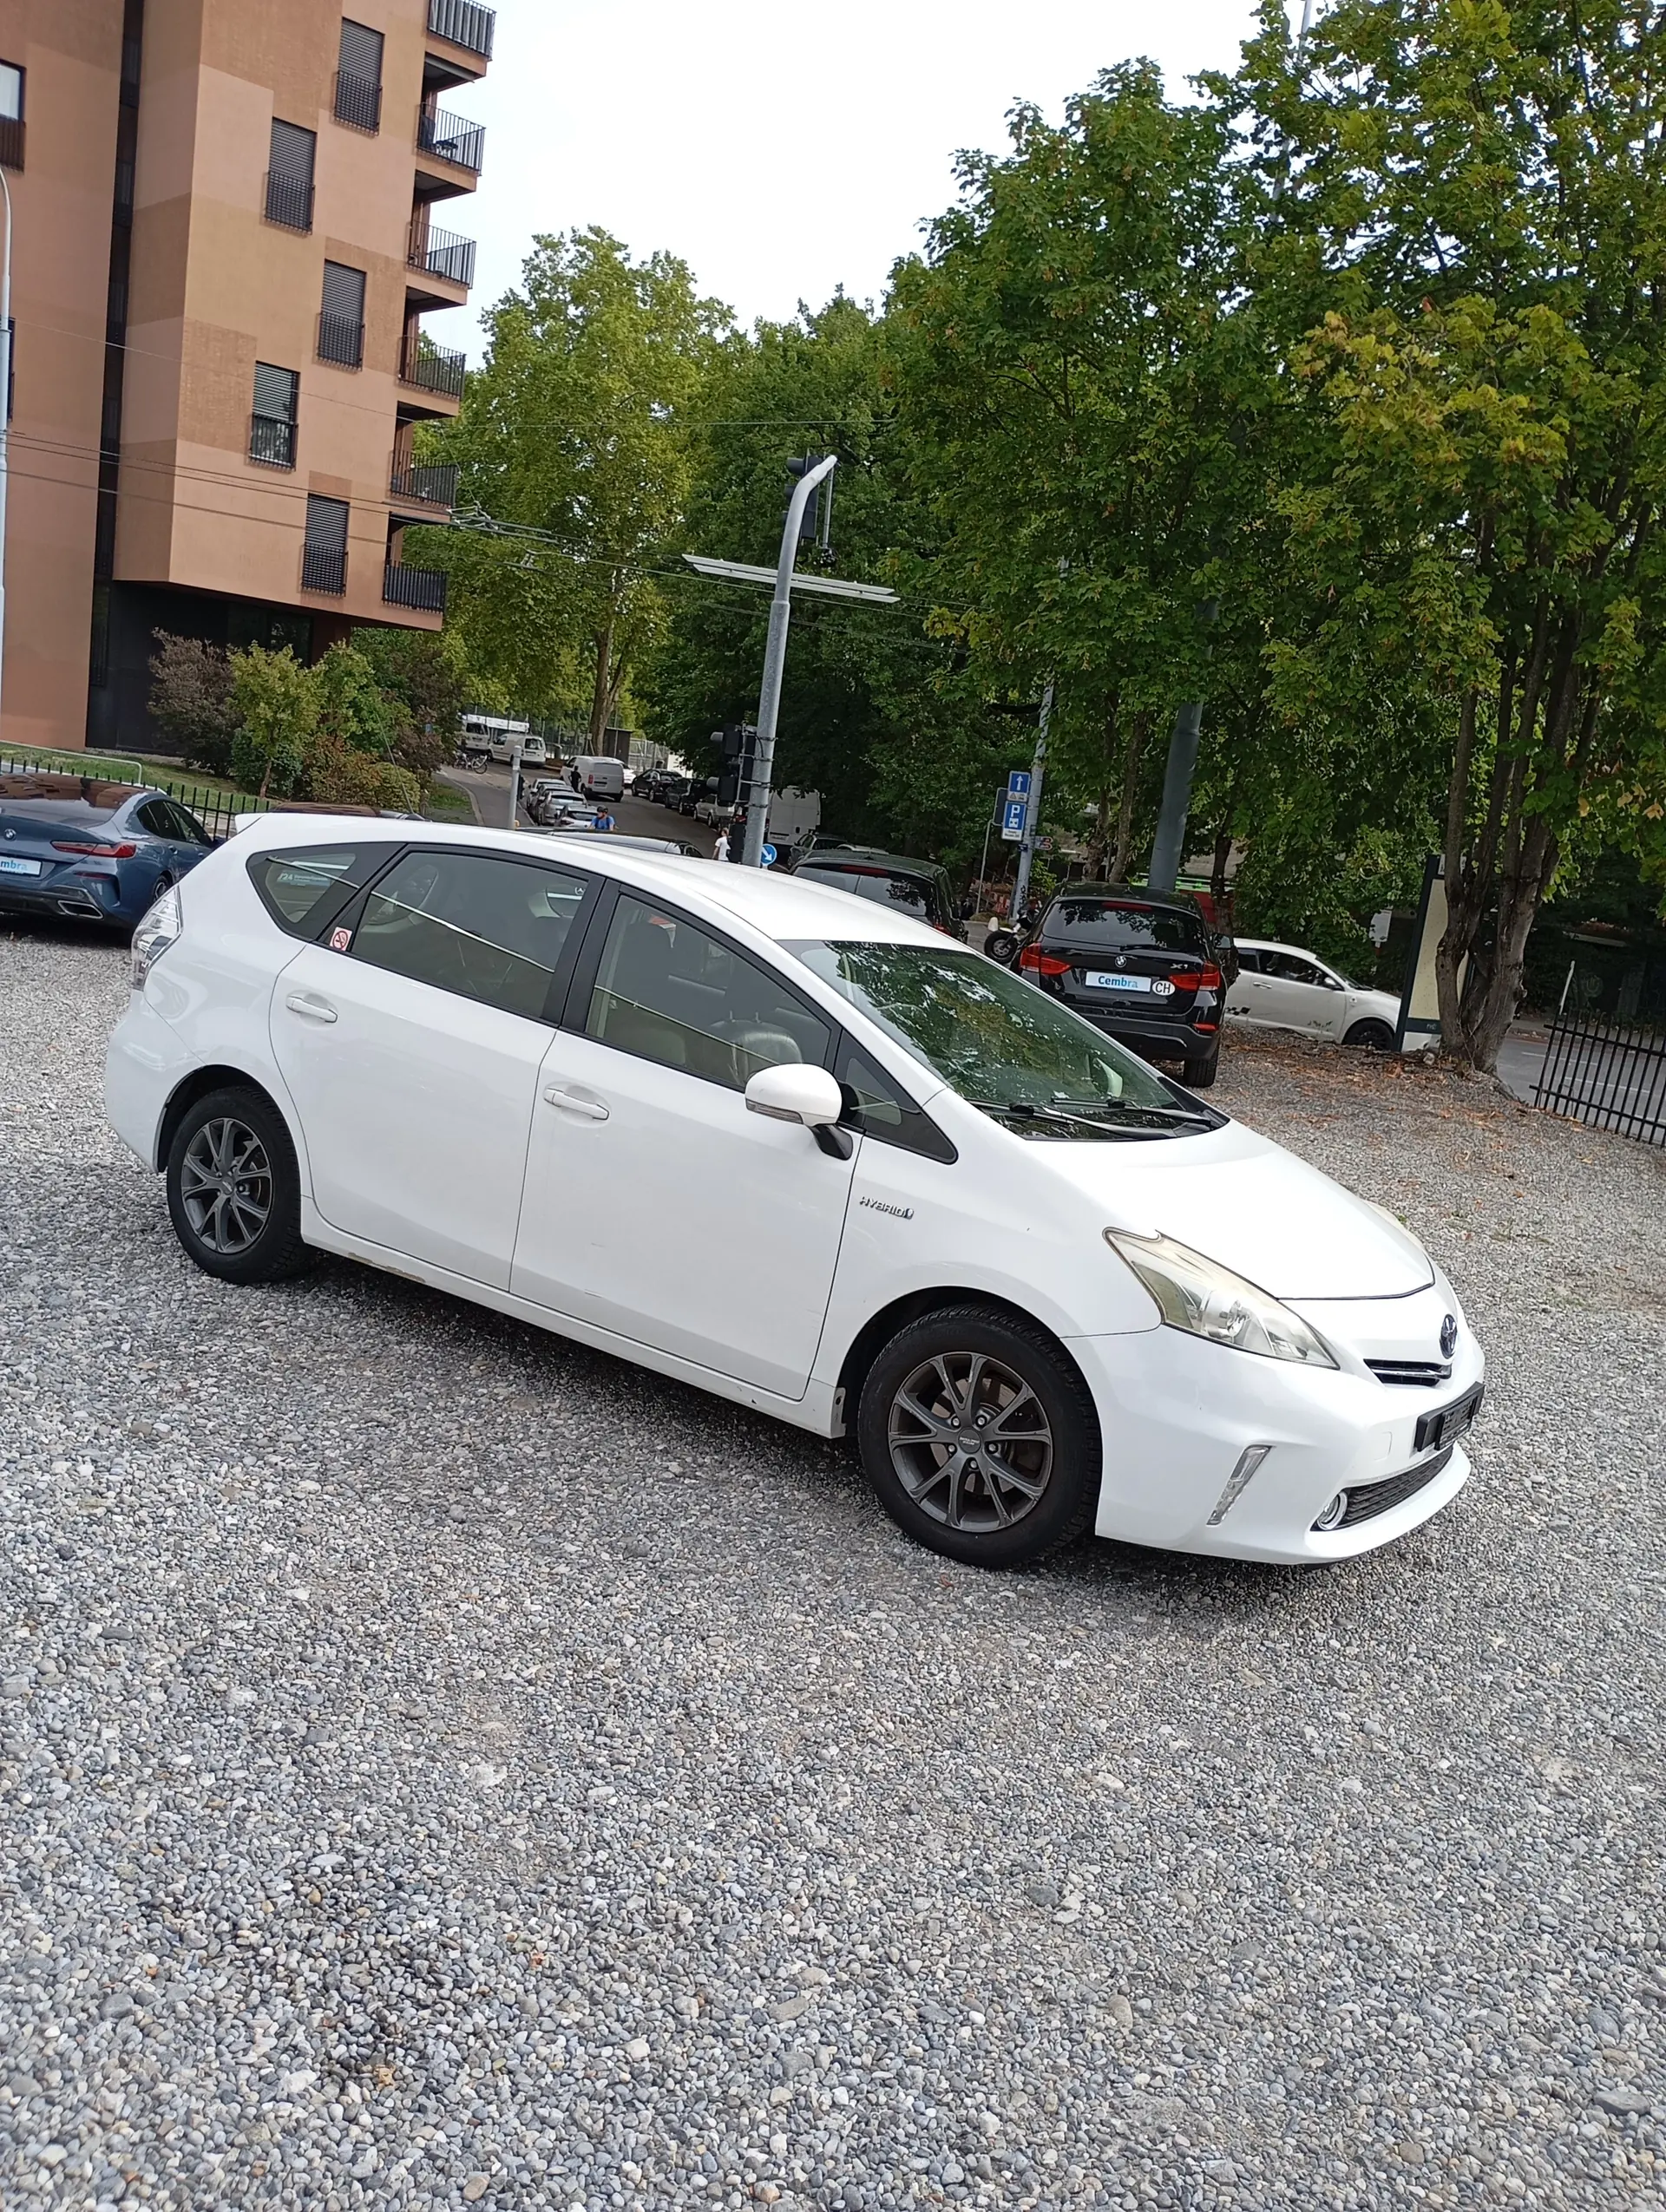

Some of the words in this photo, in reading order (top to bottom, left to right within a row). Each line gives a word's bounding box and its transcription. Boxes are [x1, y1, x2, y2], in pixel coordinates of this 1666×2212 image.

[1011, 805, 1020, 817] P
[1098, 975, 1138, 988] Cembra
[1155, 982, 1171, 993] CH
[859, 1196, 906, 1218] HYBRID
